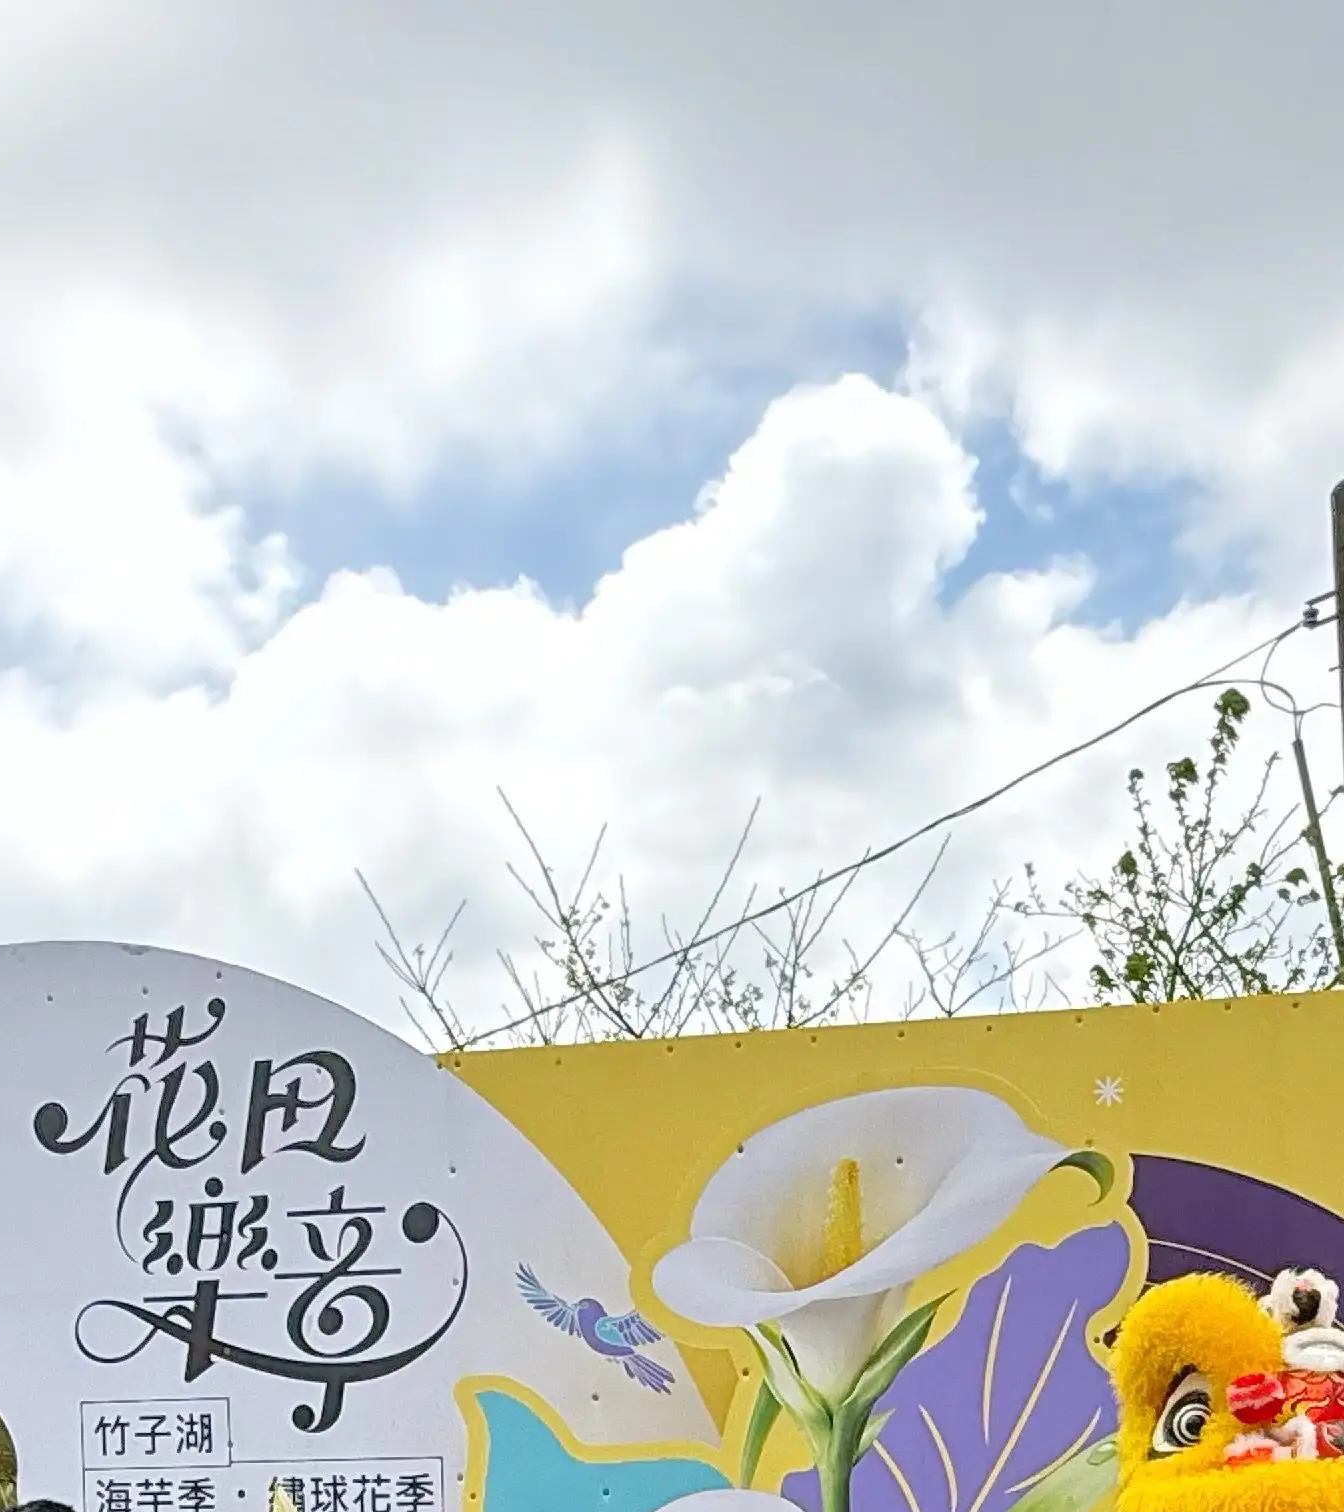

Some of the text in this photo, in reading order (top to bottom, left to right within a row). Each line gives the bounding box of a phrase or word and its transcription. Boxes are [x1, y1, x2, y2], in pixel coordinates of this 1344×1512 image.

[34, 998, 367, 1178] 花田
[75, 1176, 468, 1434] 樂音
[94, 1412, 213, 1457] 竹子湖
